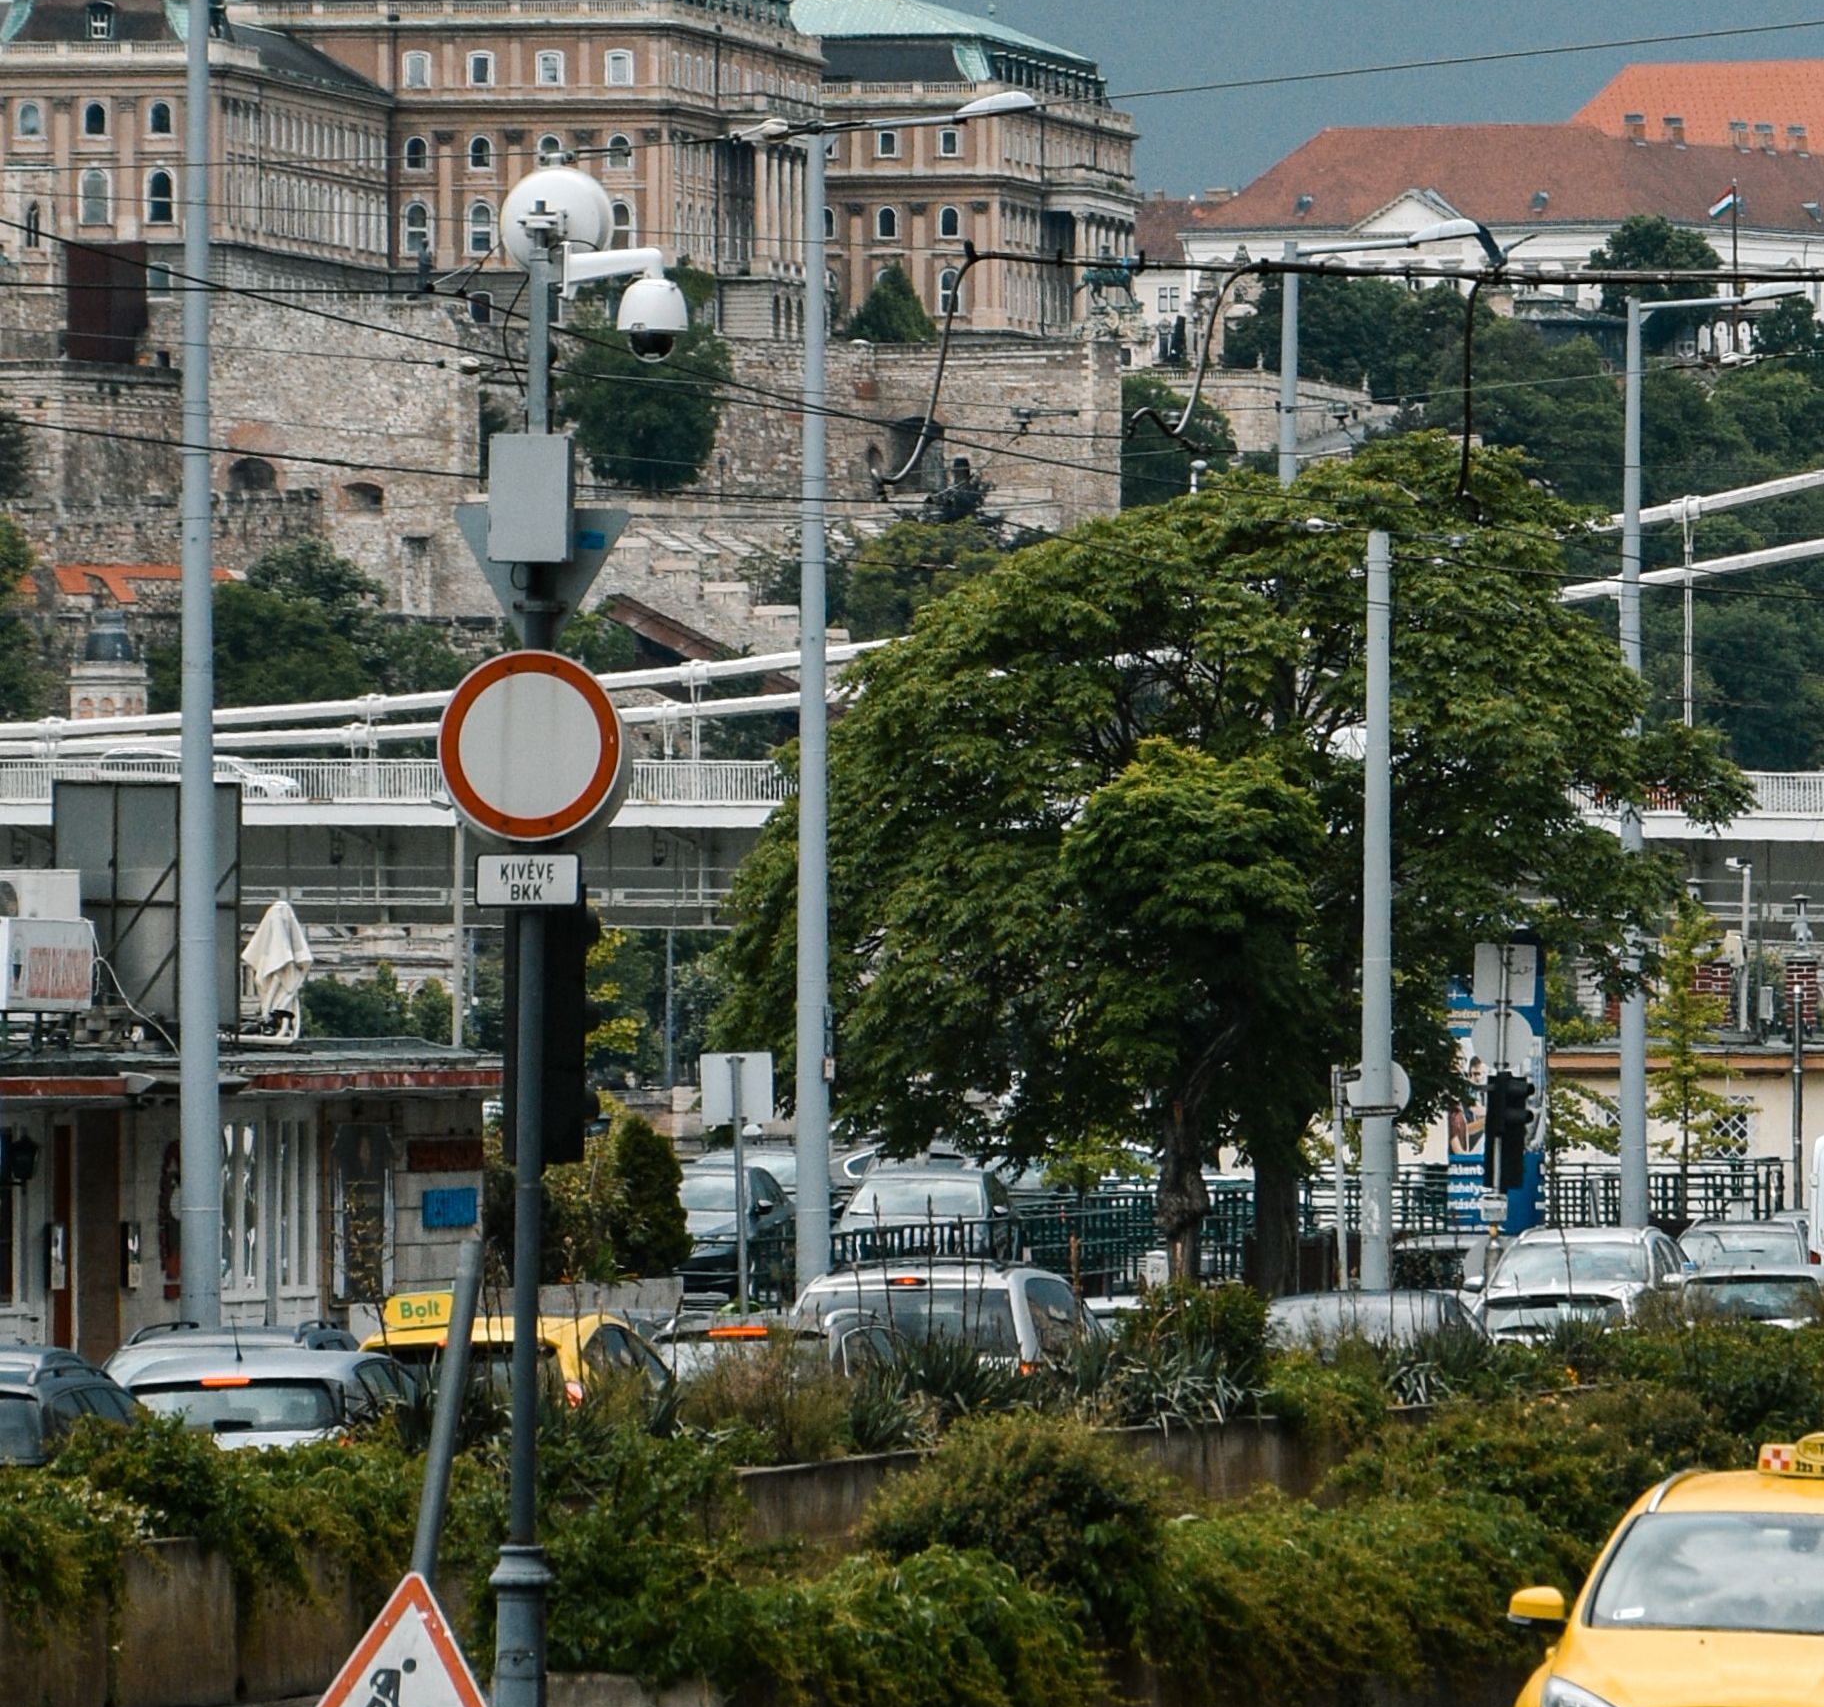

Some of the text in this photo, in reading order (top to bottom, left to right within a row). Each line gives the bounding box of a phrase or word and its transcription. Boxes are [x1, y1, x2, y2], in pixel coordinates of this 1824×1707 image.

[500, 858, 555, 885] KIVÉVE
[511, 883, 542, 901] BKK
[400, 1300, 441, 1319] Bolt
